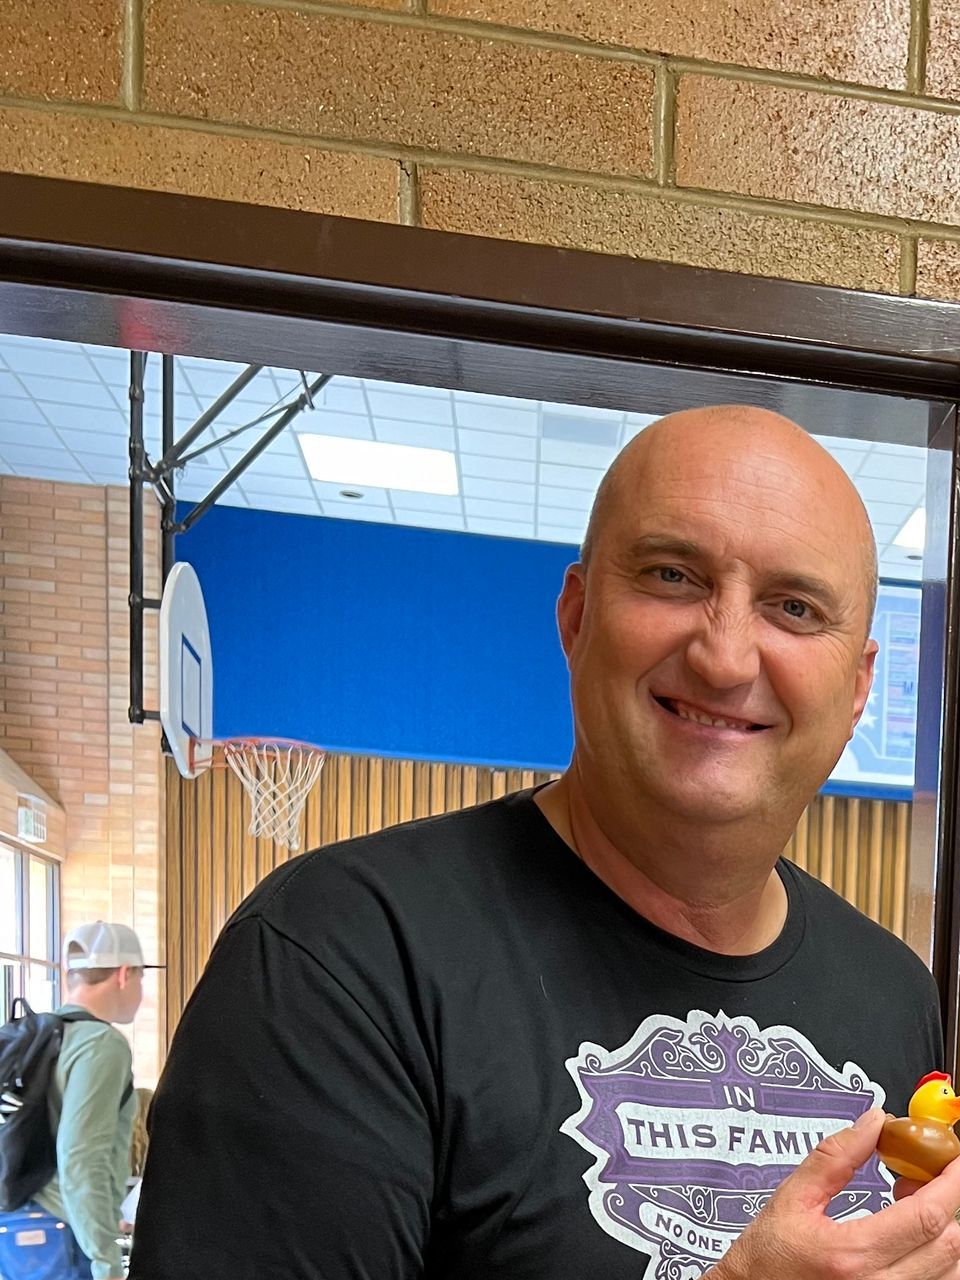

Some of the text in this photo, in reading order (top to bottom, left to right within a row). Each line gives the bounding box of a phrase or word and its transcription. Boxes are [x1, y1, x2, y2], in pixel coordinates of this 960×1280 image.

[723, 1084, 756, 1108] IN
[627, 1118, 717, 1150] THIS
[655, 1212, 723, 1253] NO ONE
